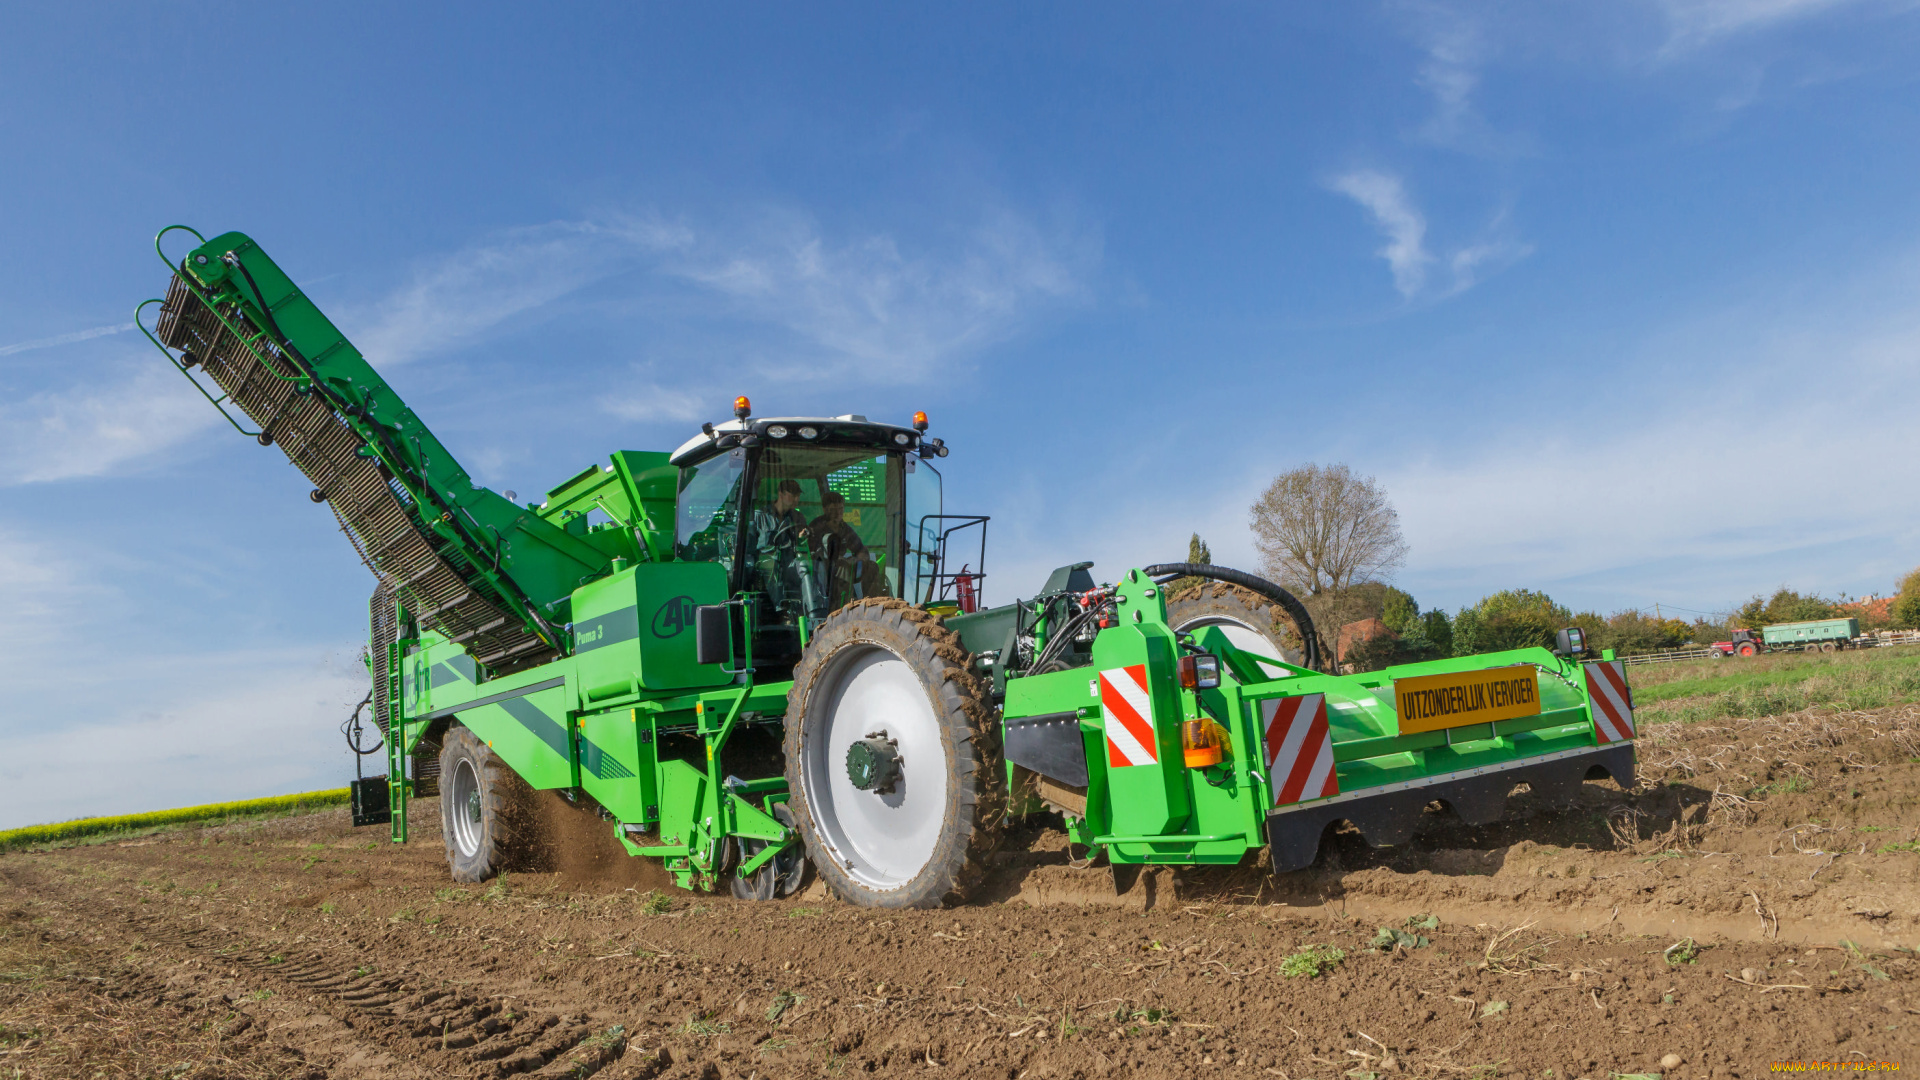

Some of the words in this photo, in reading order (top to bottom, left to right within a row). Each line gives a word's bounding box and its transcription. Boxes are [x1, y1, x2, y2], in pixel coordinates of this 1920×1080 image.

[577, 631, 596, 646] Puma
[598, 624, 603, 640] 3
[1402, 683, 1487, 720] UITZONDERLIJK
[1486, 678, 1535, 708] VERVOER
